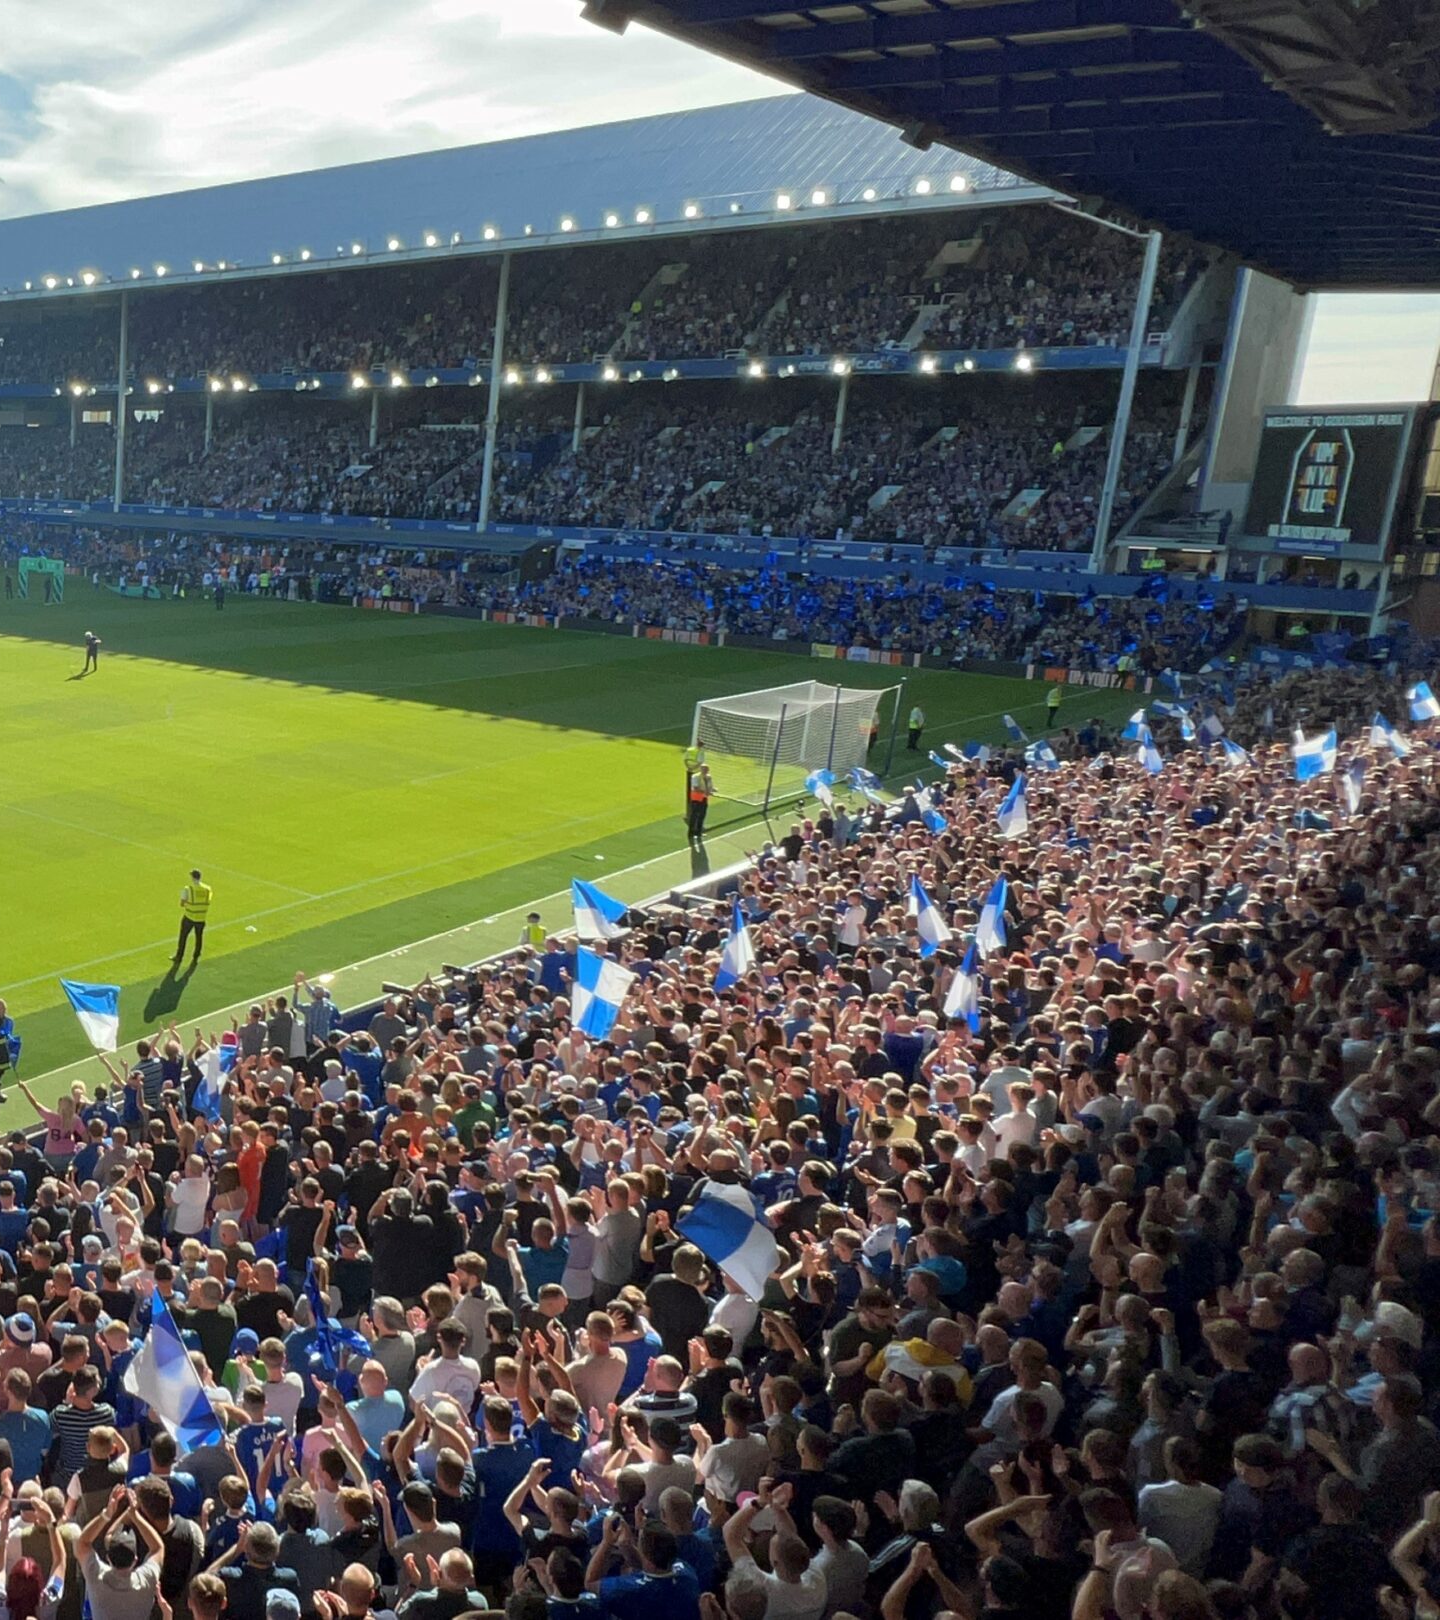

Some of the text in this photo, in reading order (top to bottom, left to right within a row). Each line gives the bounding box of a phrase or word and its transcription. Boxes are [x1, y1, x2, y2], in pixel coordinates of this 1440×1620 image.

[1266, 416, 1310, 427] WELCOME
[1312, 415, 1324, 427] TO
[1377, 414, 1405, 425] PARK
